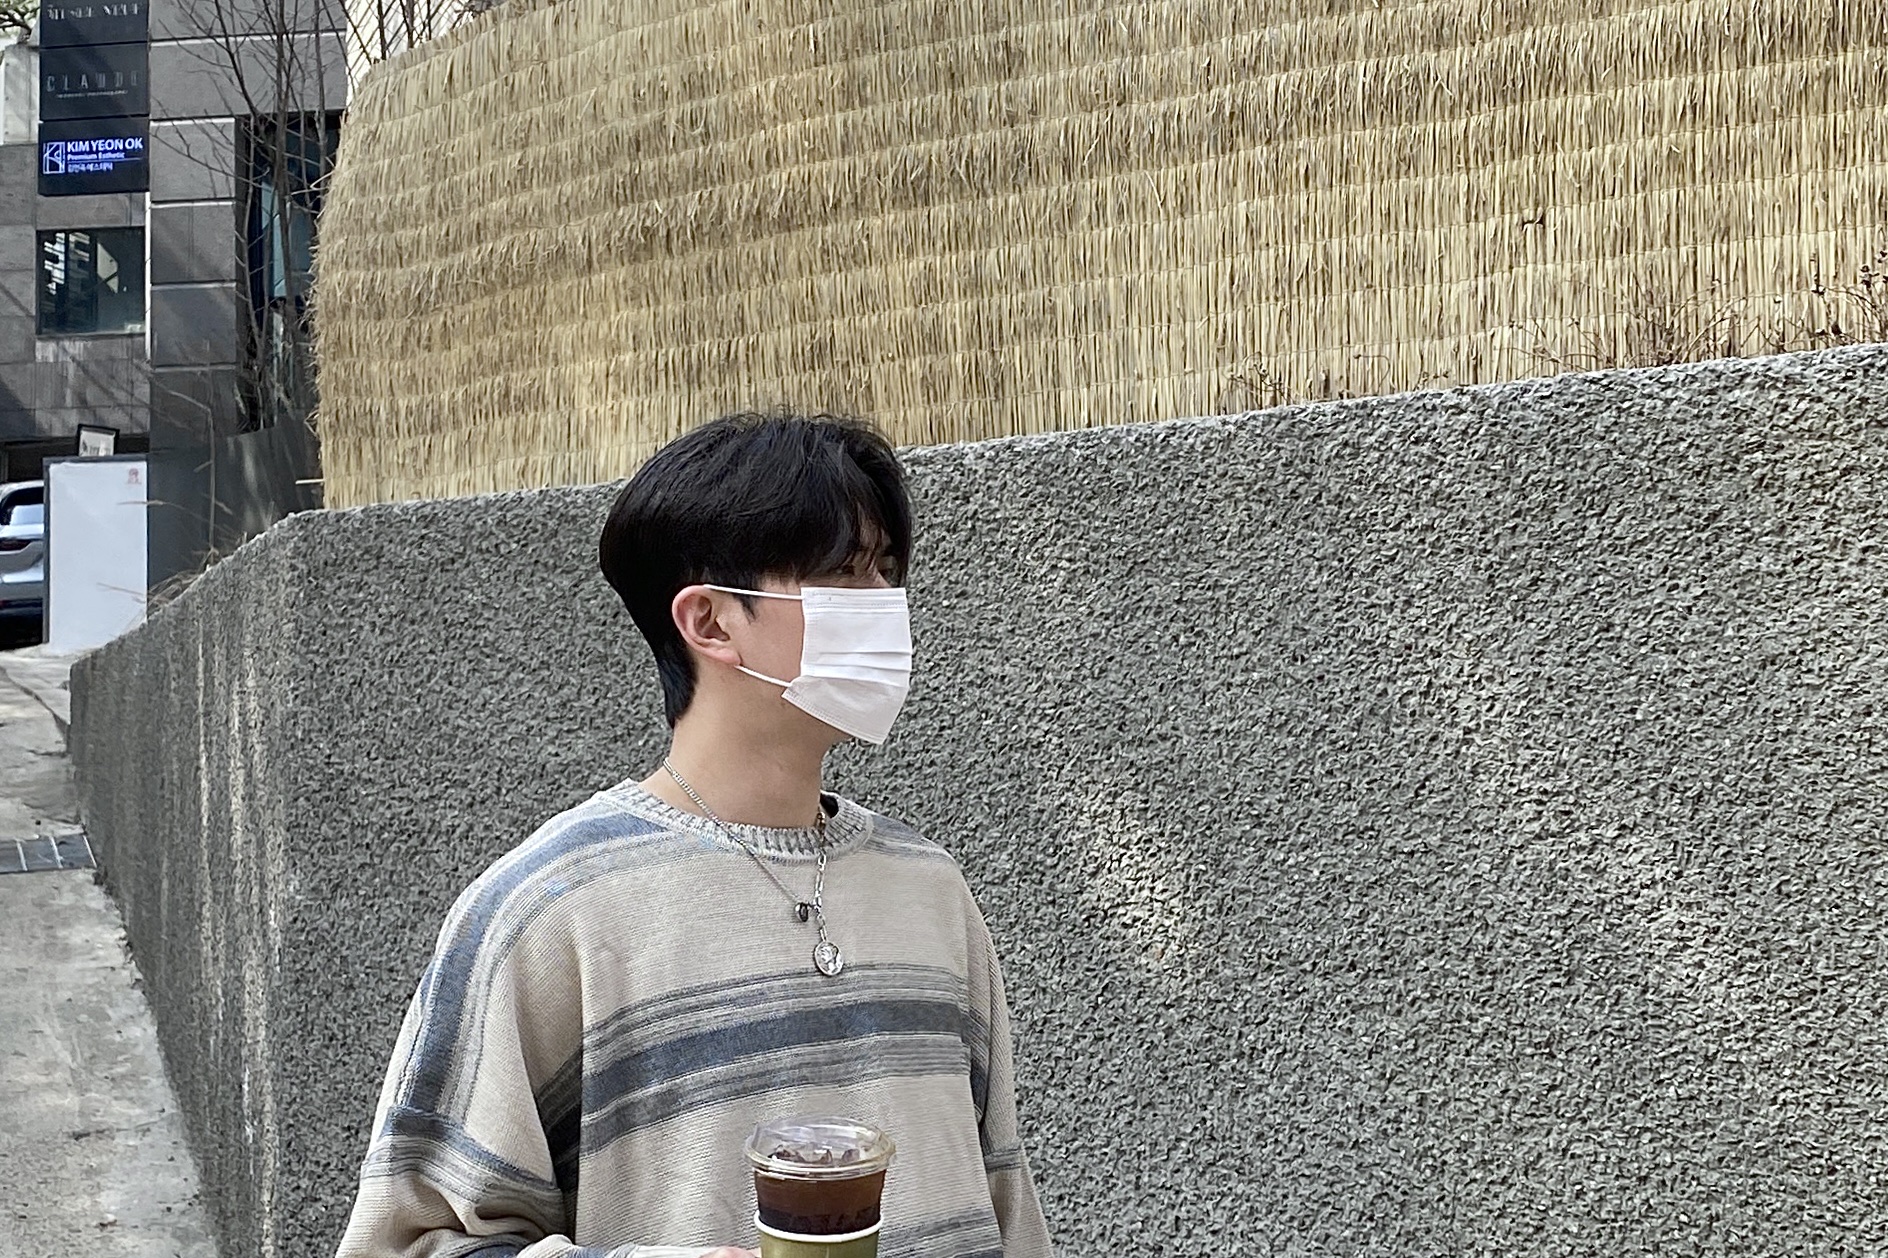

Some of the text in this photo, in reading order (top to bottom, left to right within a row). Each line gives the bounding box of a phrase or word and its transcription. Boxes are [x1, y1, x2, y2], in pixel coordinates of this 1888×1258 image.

[67, 137, 143, 152] KIM YEON OK
